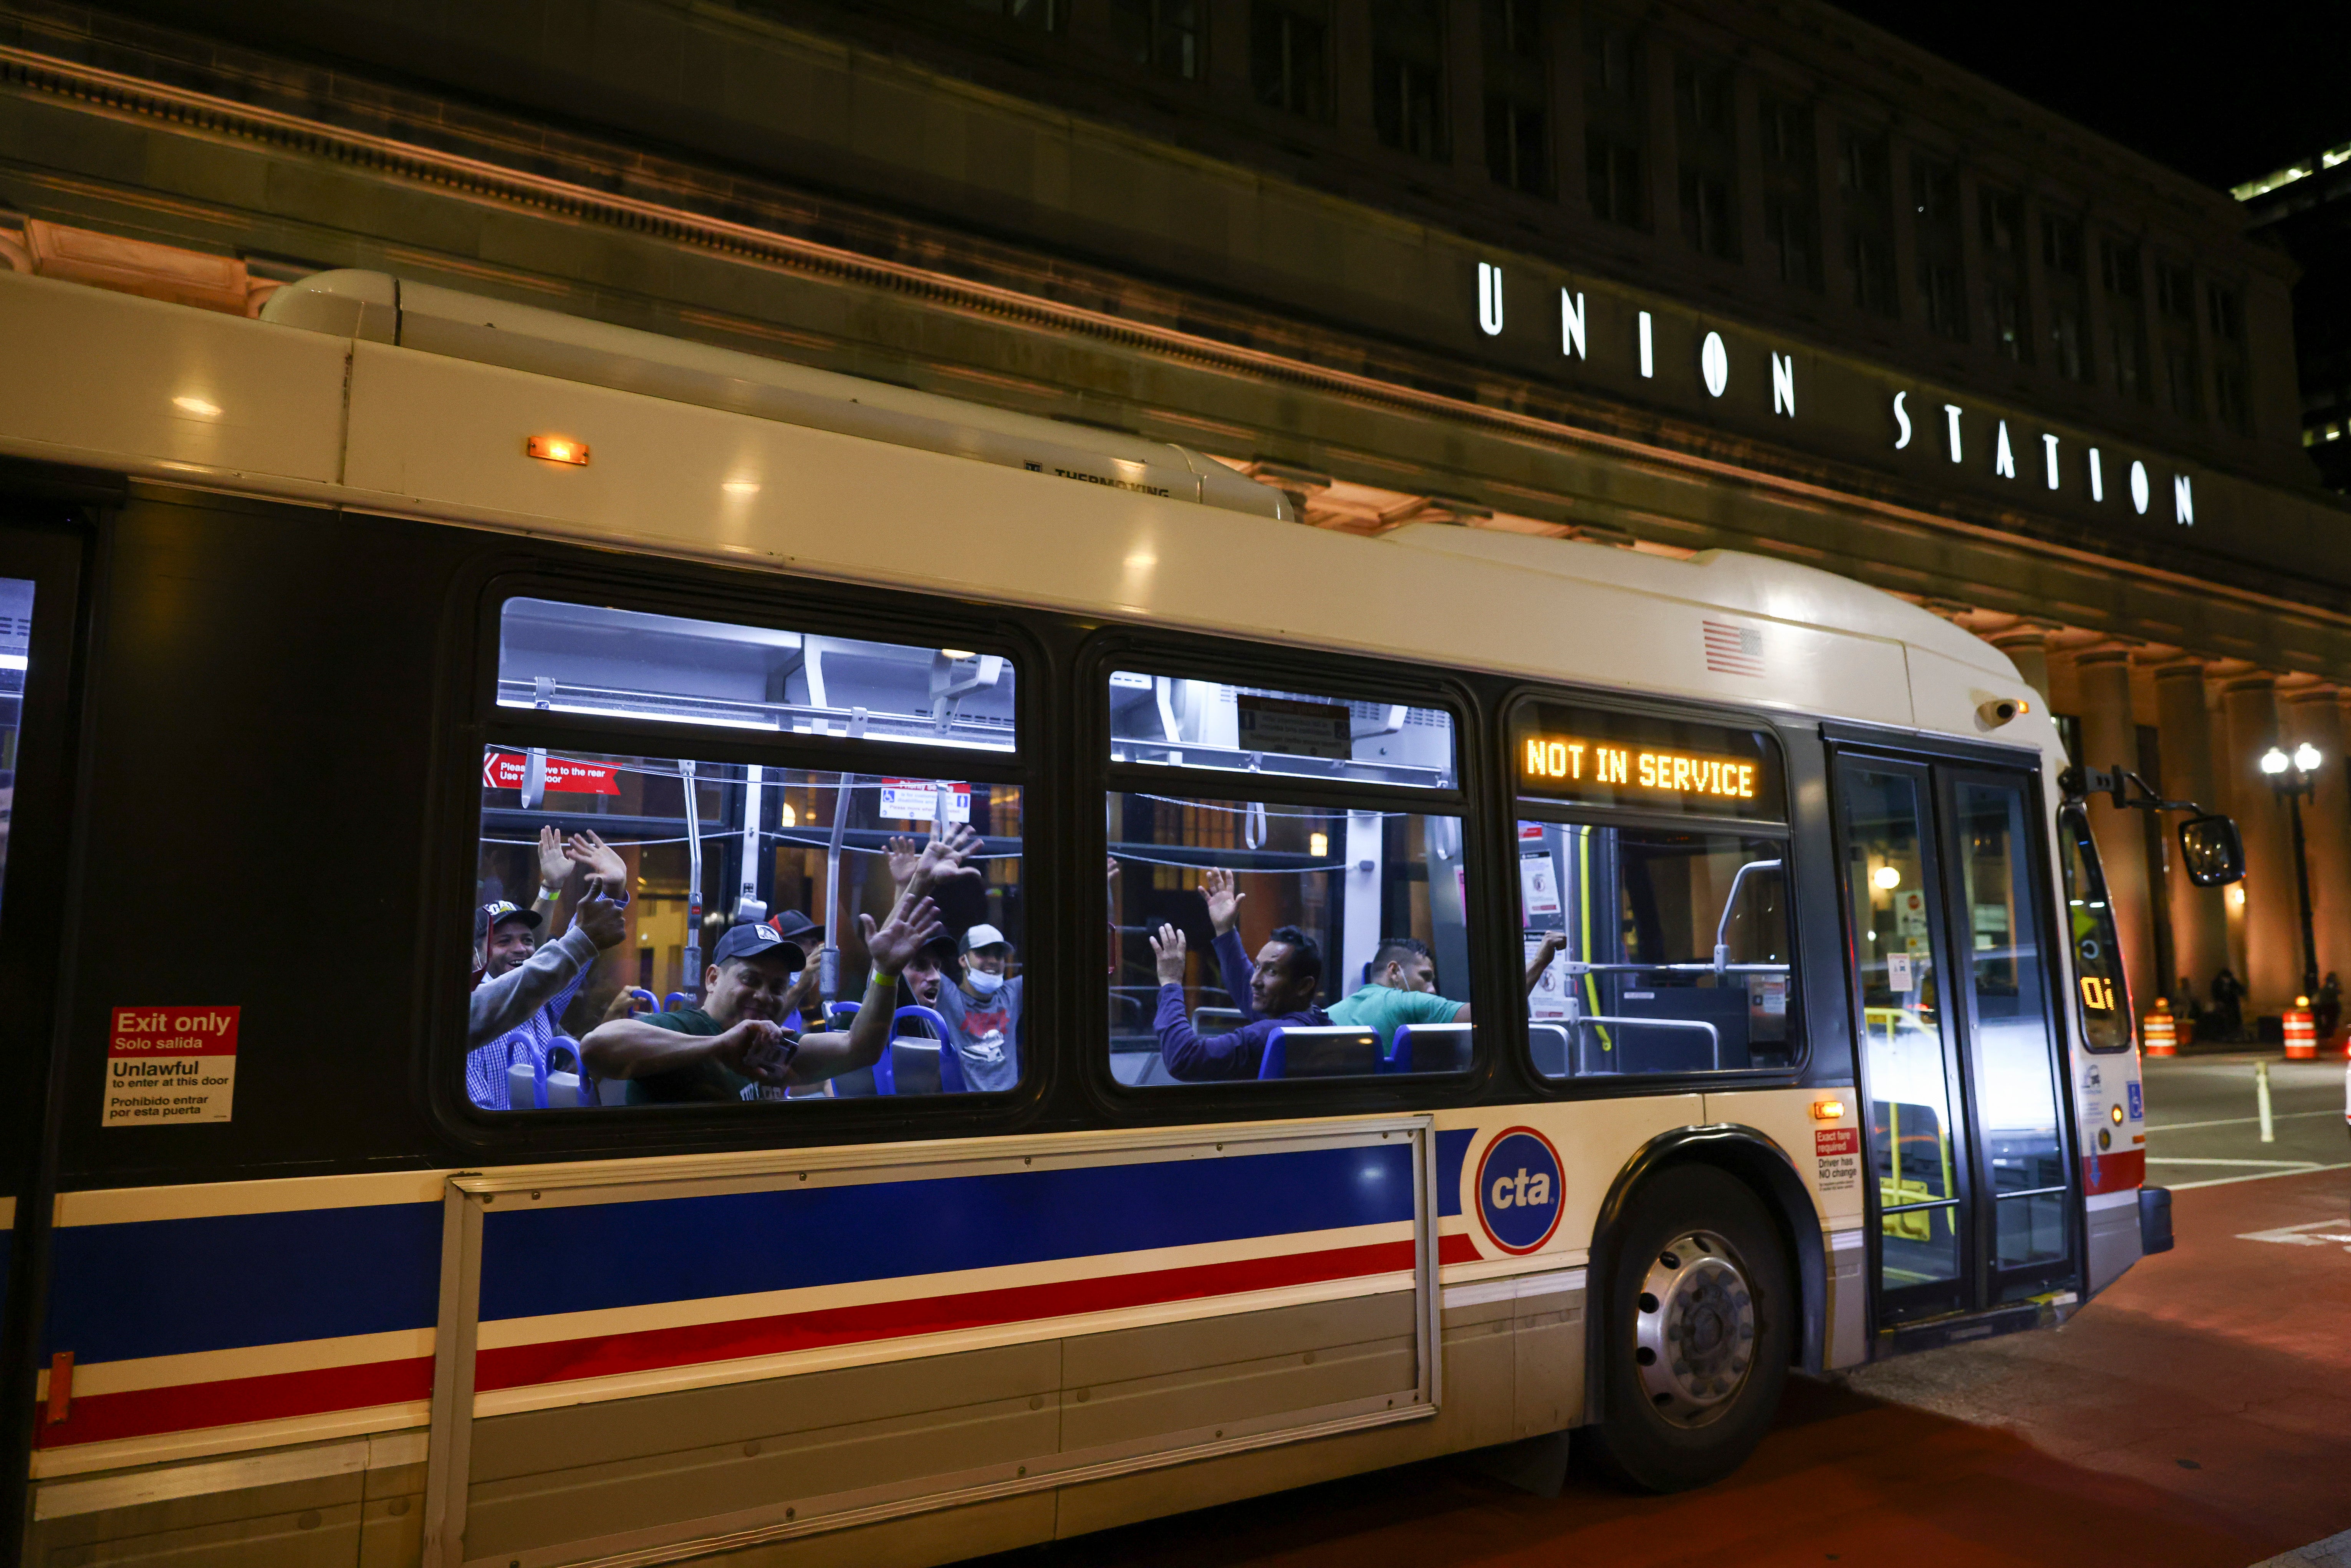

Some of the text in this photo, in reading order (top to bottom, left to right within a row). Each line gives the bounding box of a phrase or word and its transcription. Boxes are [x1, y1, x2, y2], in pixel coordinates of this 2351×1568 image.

[1478, 262, 2194, 526] UNION STATION
[500, 762, 525, 772] Pleas
[560, 766, 570, 775] to
[571, 767, 586, 776] the
[588, 769, 606, 778] rear
[1527, 739, 1752, 797] NOT IN SERVICE
[500, 771, 518, 780] Use
[118, 1012, 231, 1036] Exit only
[115, 1037, 203, 1050] Solo salida
[113, 1061, 199, 1076] Unlawful
[113, 1076, 229, 1088] to enter at this door
[111, 1096, 208, 1107] Prohibido entrar
[110, 1106, 200, 1119] por esta puerta
[1818, 1157, 1853, 1168] Driver has
[1819, 1168, 1857, 1179] NO change
[1492, 1168, 1550, 1209] cta
